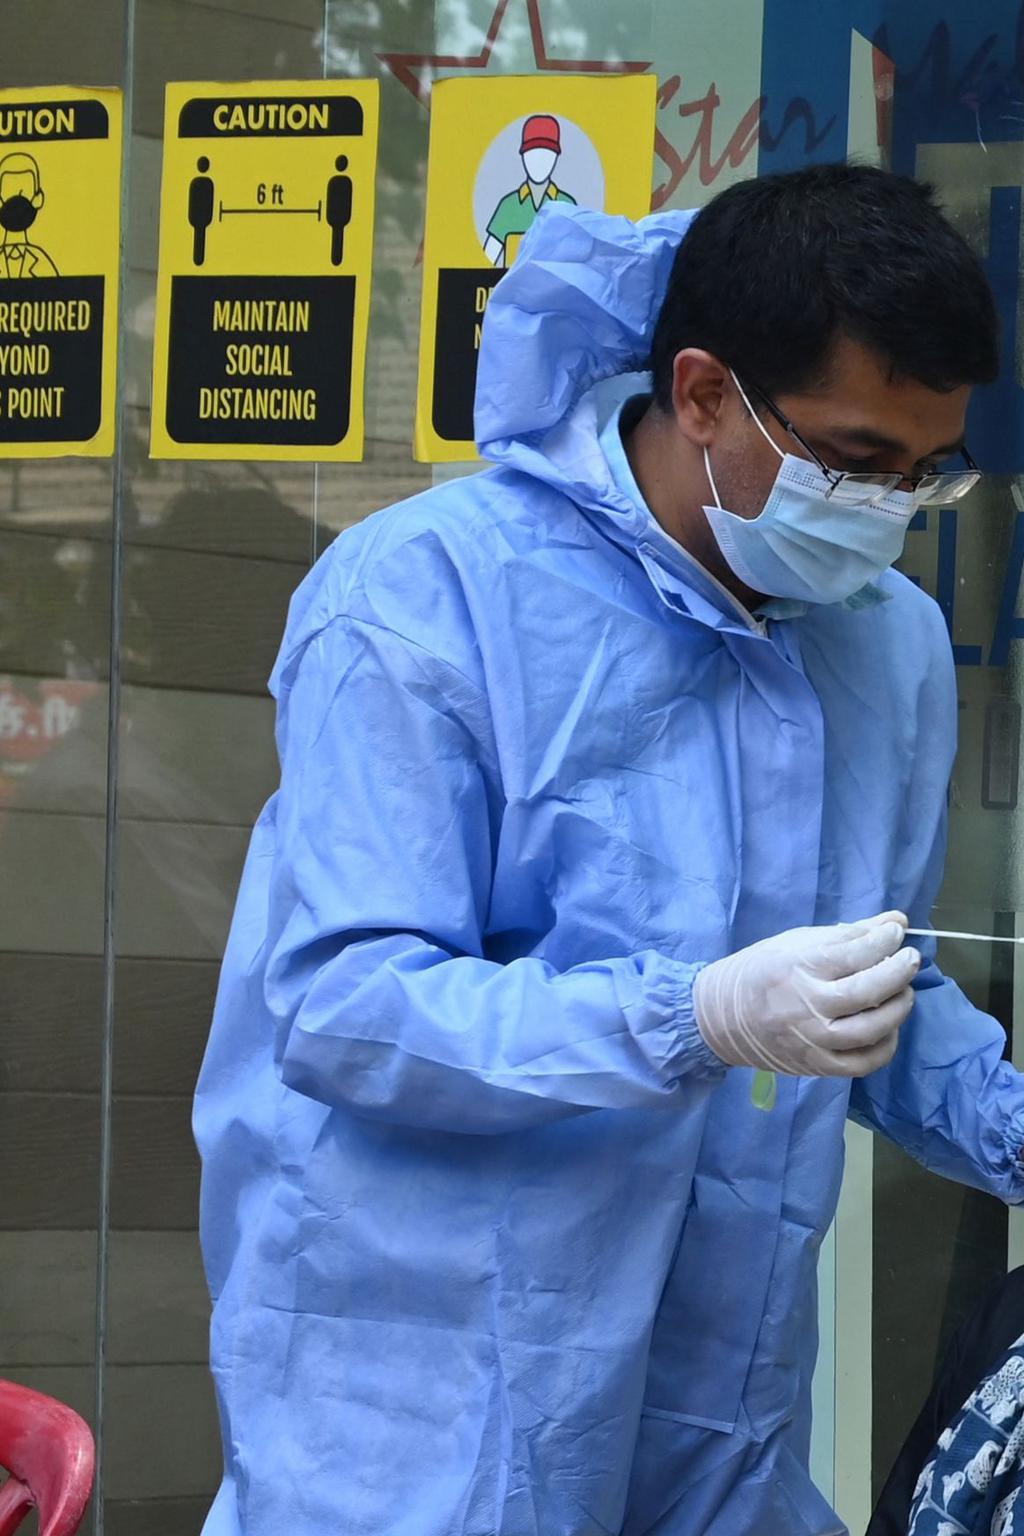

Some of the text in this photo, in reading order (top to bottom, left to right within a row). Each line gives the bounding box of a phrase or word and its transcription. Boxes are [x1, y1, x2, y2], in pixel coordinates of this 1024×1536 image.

[212, 103, 329, 131] CAUTION
[256, 183, 284, 205] 6 ft
[212, 300, 310, 333] MAINTAIN
[225, 343, 293, 376] SOCIAL
[7, 386, 65, 420] POINT
[198, 387, 317, 421] DISTANCING
